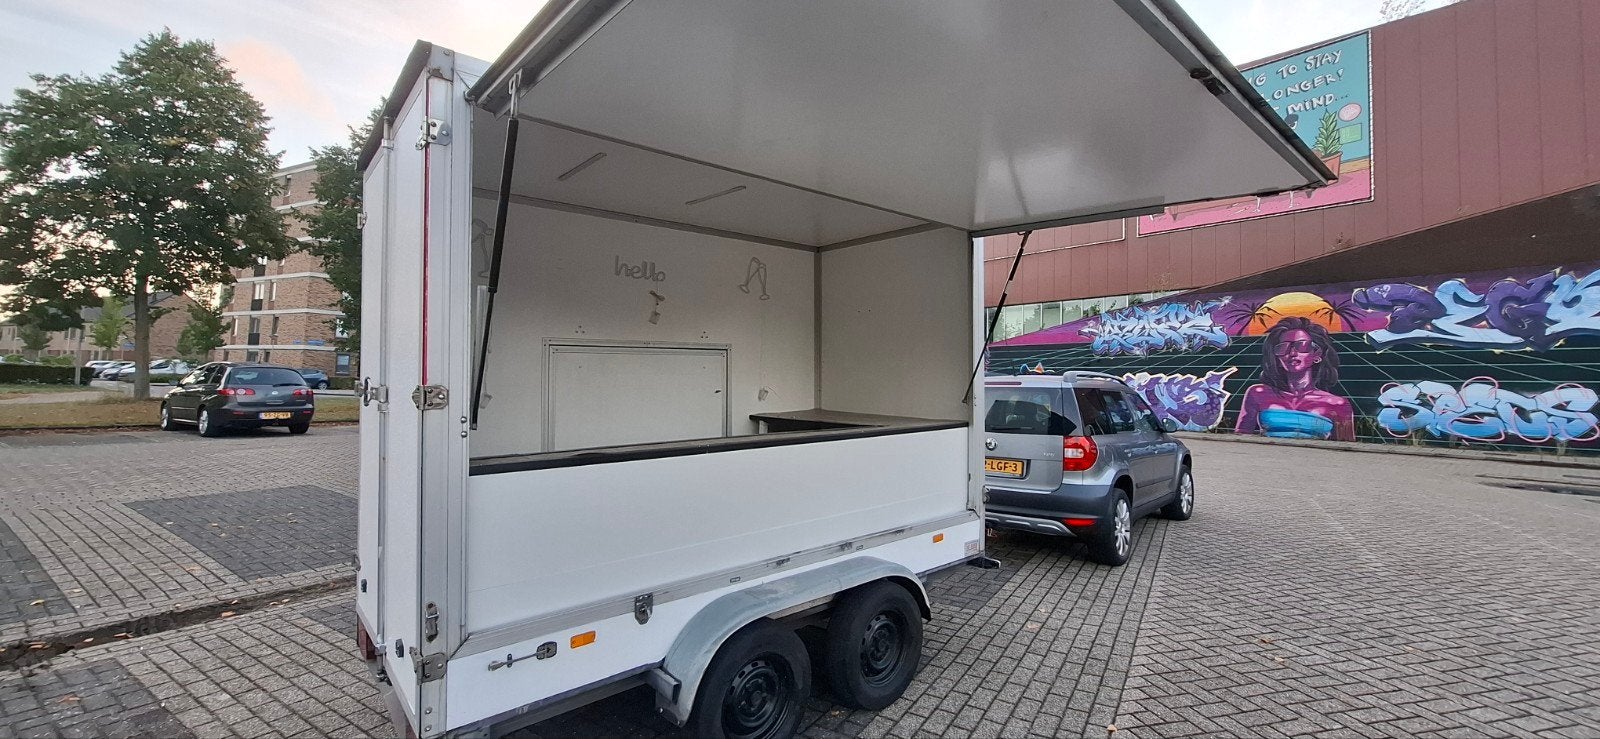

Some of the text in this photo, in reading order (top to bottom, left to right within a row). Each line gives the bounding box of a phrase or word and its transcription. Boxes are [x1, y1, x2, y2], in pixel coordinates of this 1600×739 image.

[1276, 64, 1298, 79] TO
[1304, 49, 1343, 71] STAY
[615, 255, 666, 282] hello
